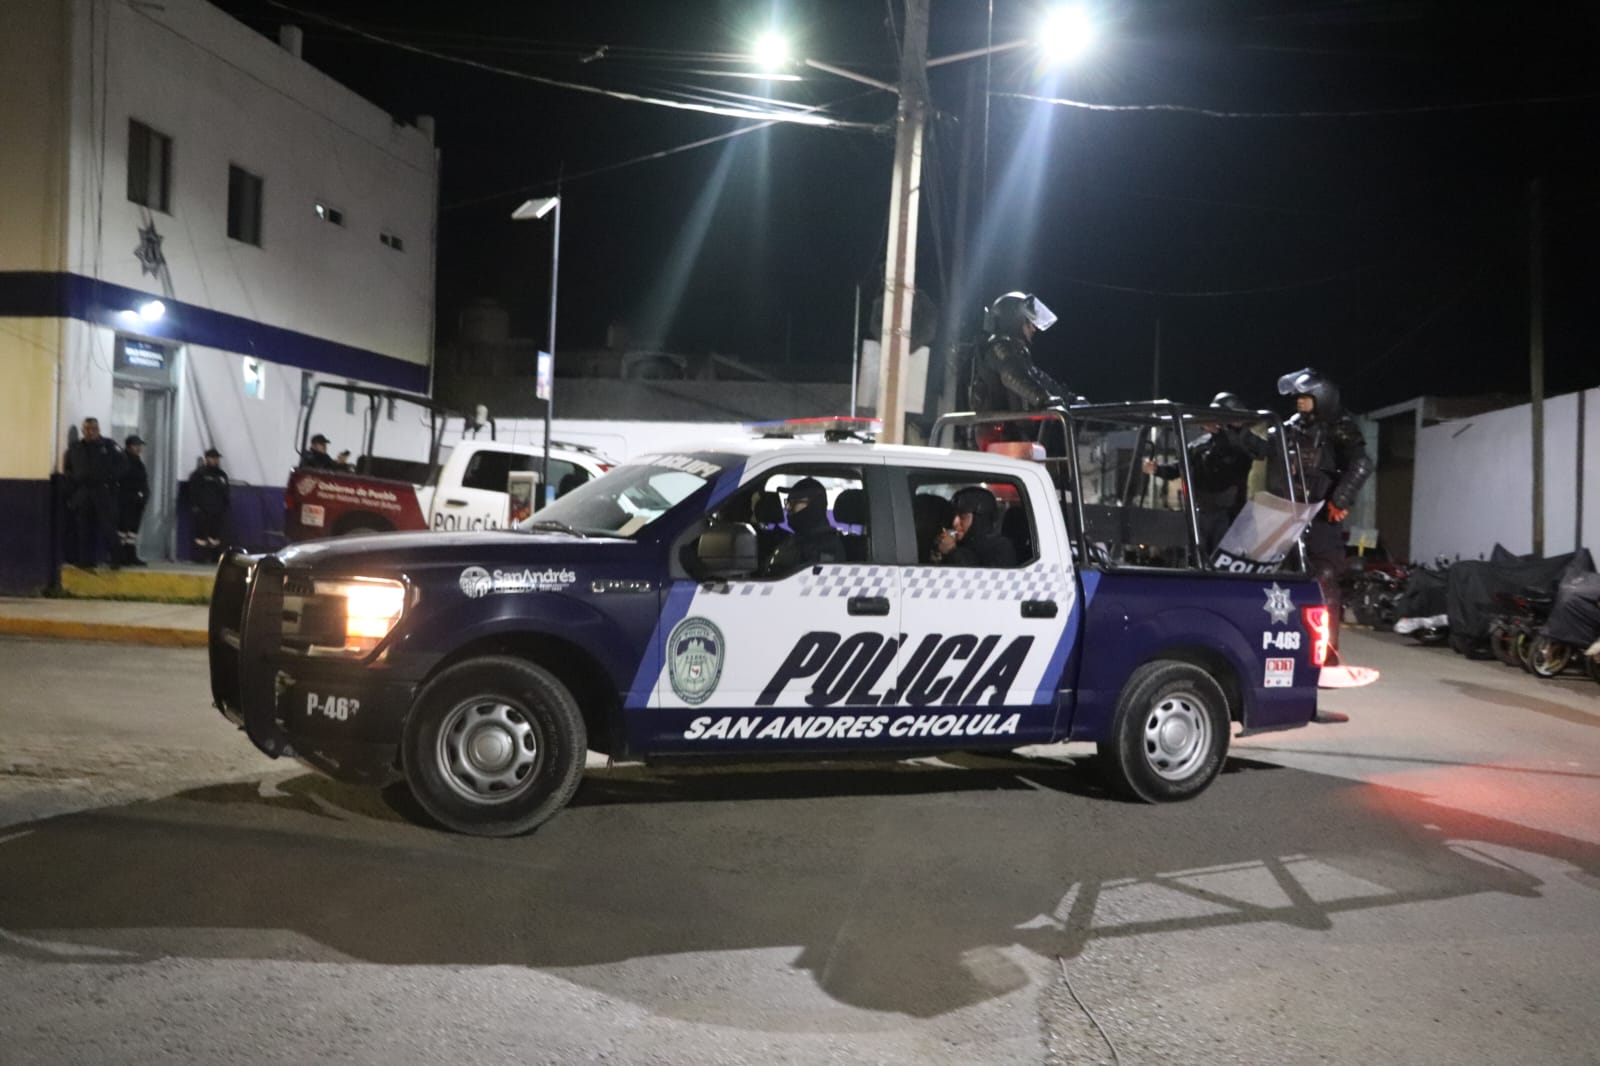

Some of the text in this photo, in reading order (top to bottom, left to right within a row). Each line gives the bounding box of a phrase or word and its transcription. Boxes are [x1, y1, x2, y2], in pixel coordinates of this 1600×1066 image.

[1263, 631, 1301, 650] P-463
[755, 631, 1035, 706] POLICIA
[684, 713, 1021, 739] SAN ANDRES CHOLULA
